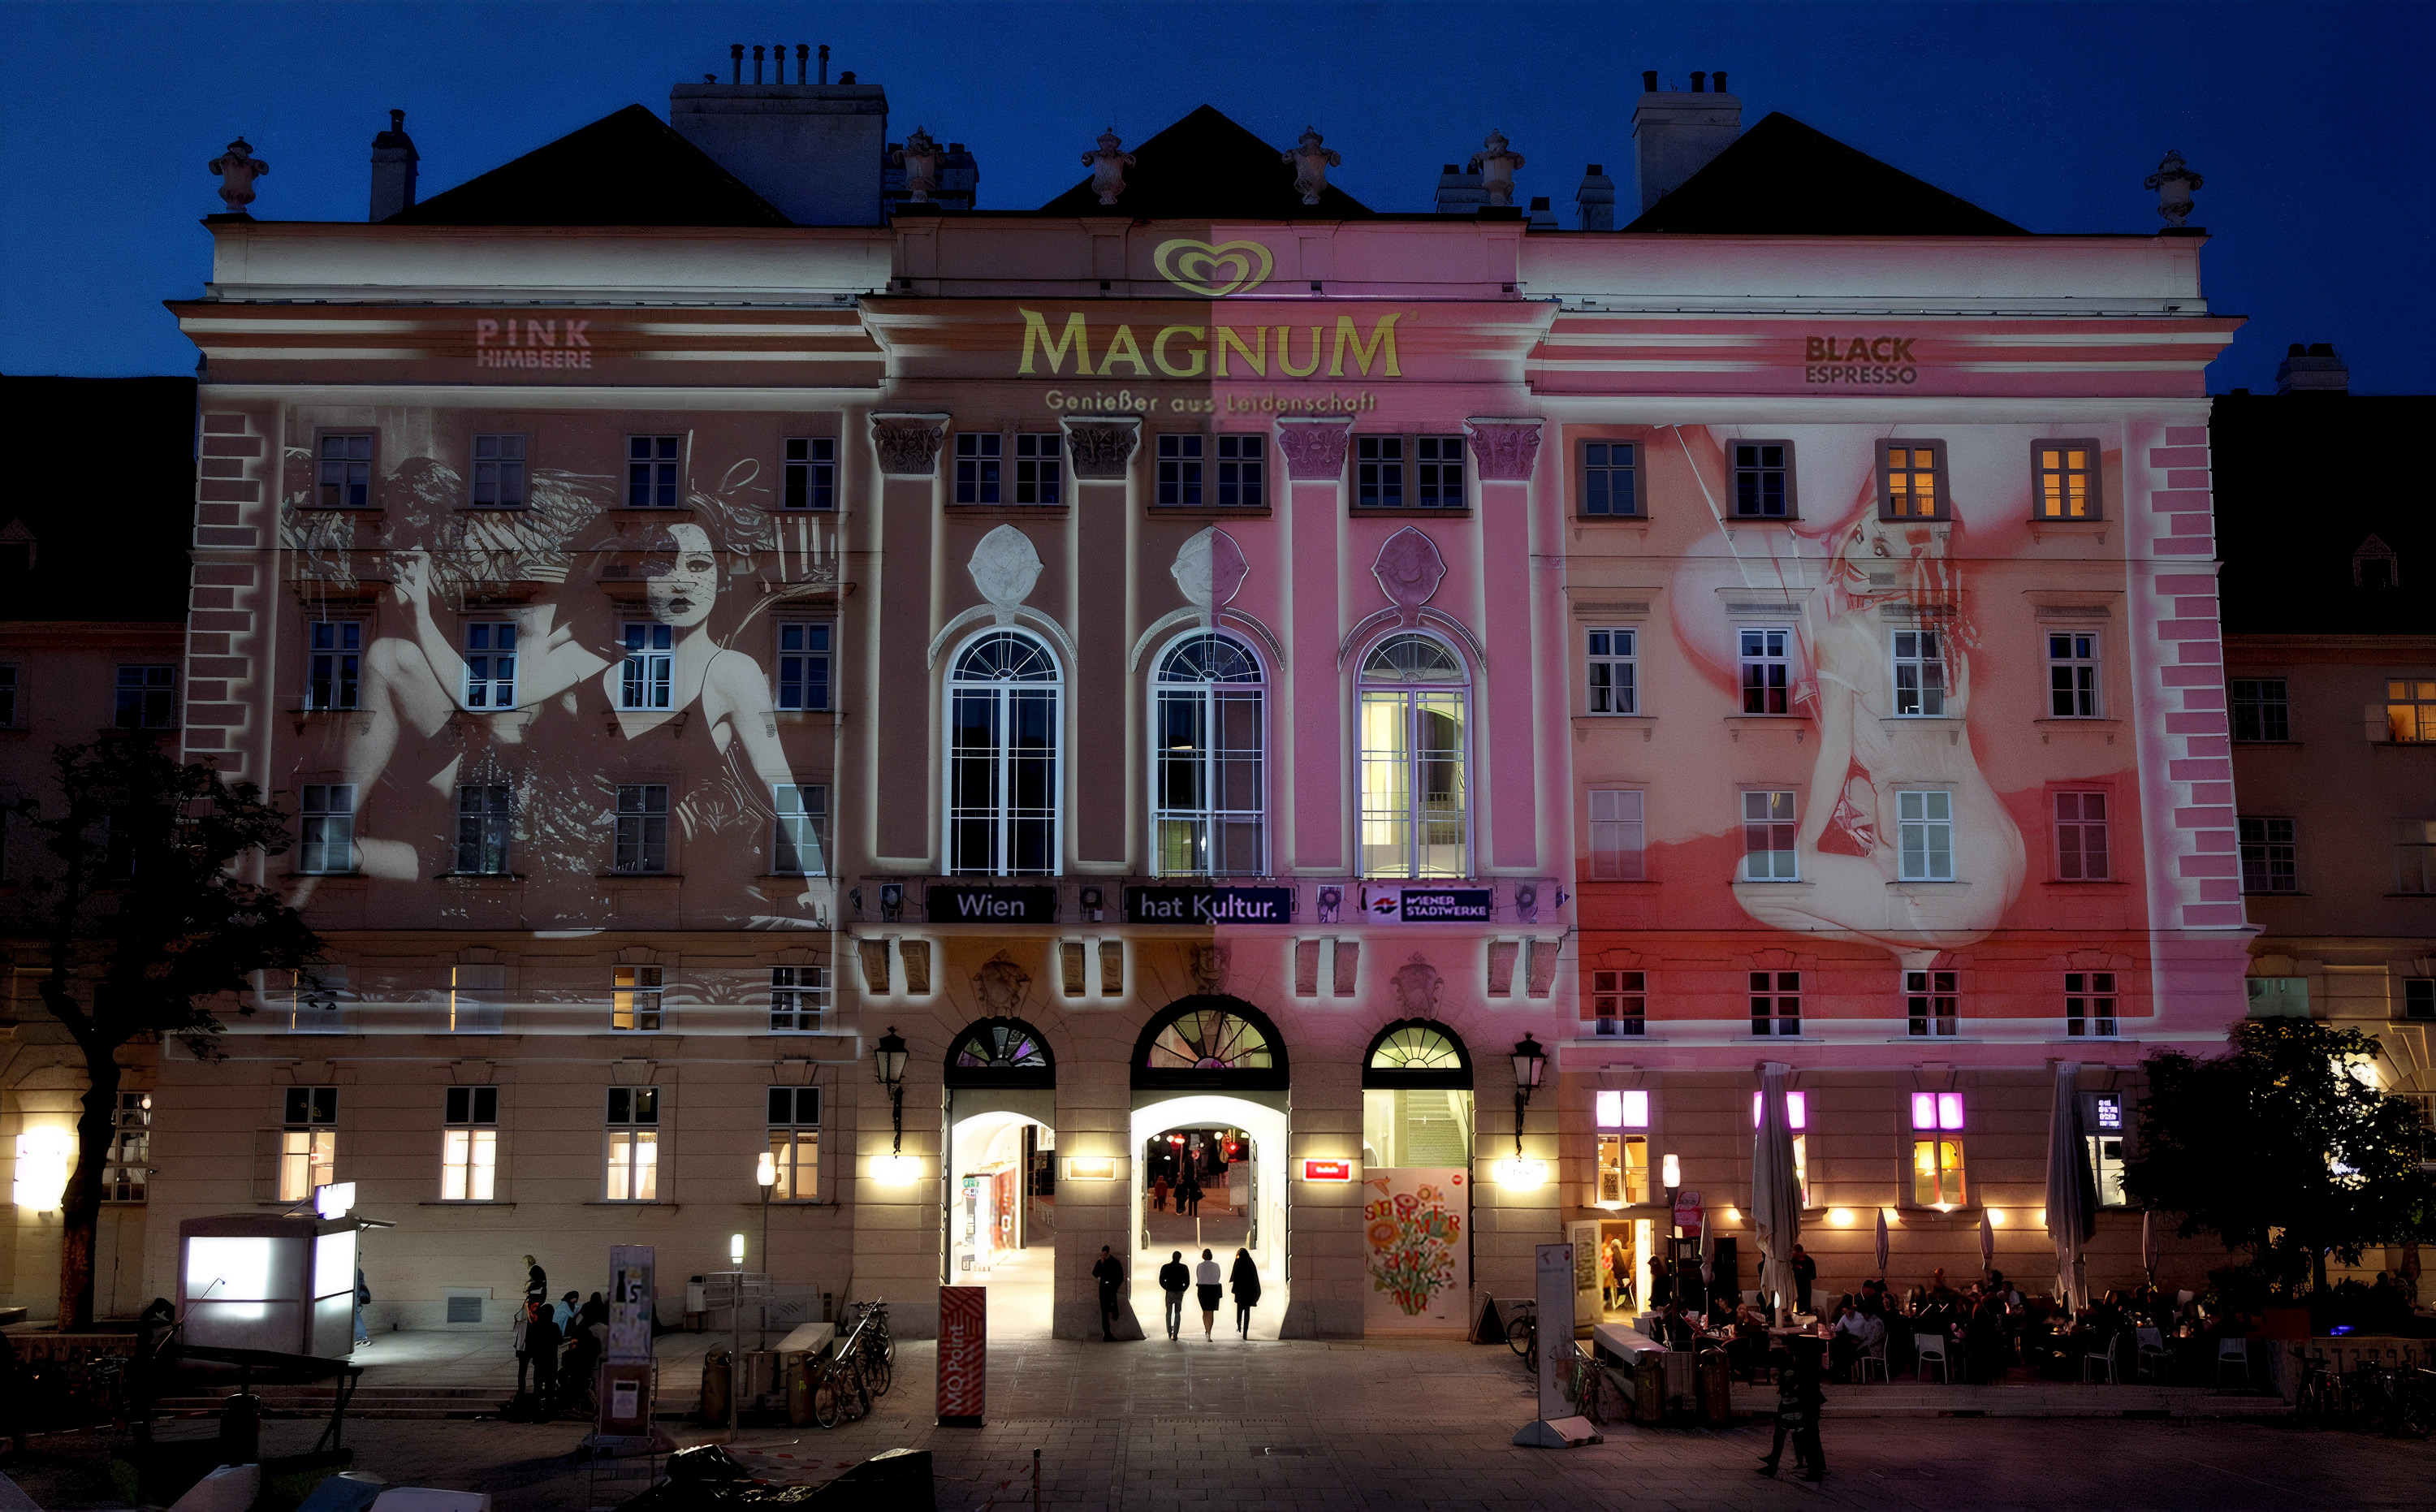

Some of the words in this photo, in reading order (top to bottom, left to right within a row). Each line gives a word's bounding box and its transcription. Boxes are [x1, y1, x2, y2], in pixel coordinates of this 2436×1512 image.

[477, 318, 591, 347] PINK
[1017, 303, 1402, 378] MAGNUM
[477, 349, 592, 369] HIMBEERE
[1806, 335, 1918, 363] BLACK
[1806, 365, 1917, 385] ESPRESSO
[1045, 389, 1158, 412] Genießer
[1171, 397, 1215, 413] aus
[1227, 391, 1376, 412] Leidenschaft
[957, 893, 1025, 918] Wien
[1141, 893, 1183, 918] hat
[1193, 892, 1277, 925] Kultur.
[1406, 895, 1455, 906] WIENER
[1406, 905, 1487, 917] STADTWERKE
[948, 1324, 965, 1372] Point
[947, 1376, 965, 1411] MQ
